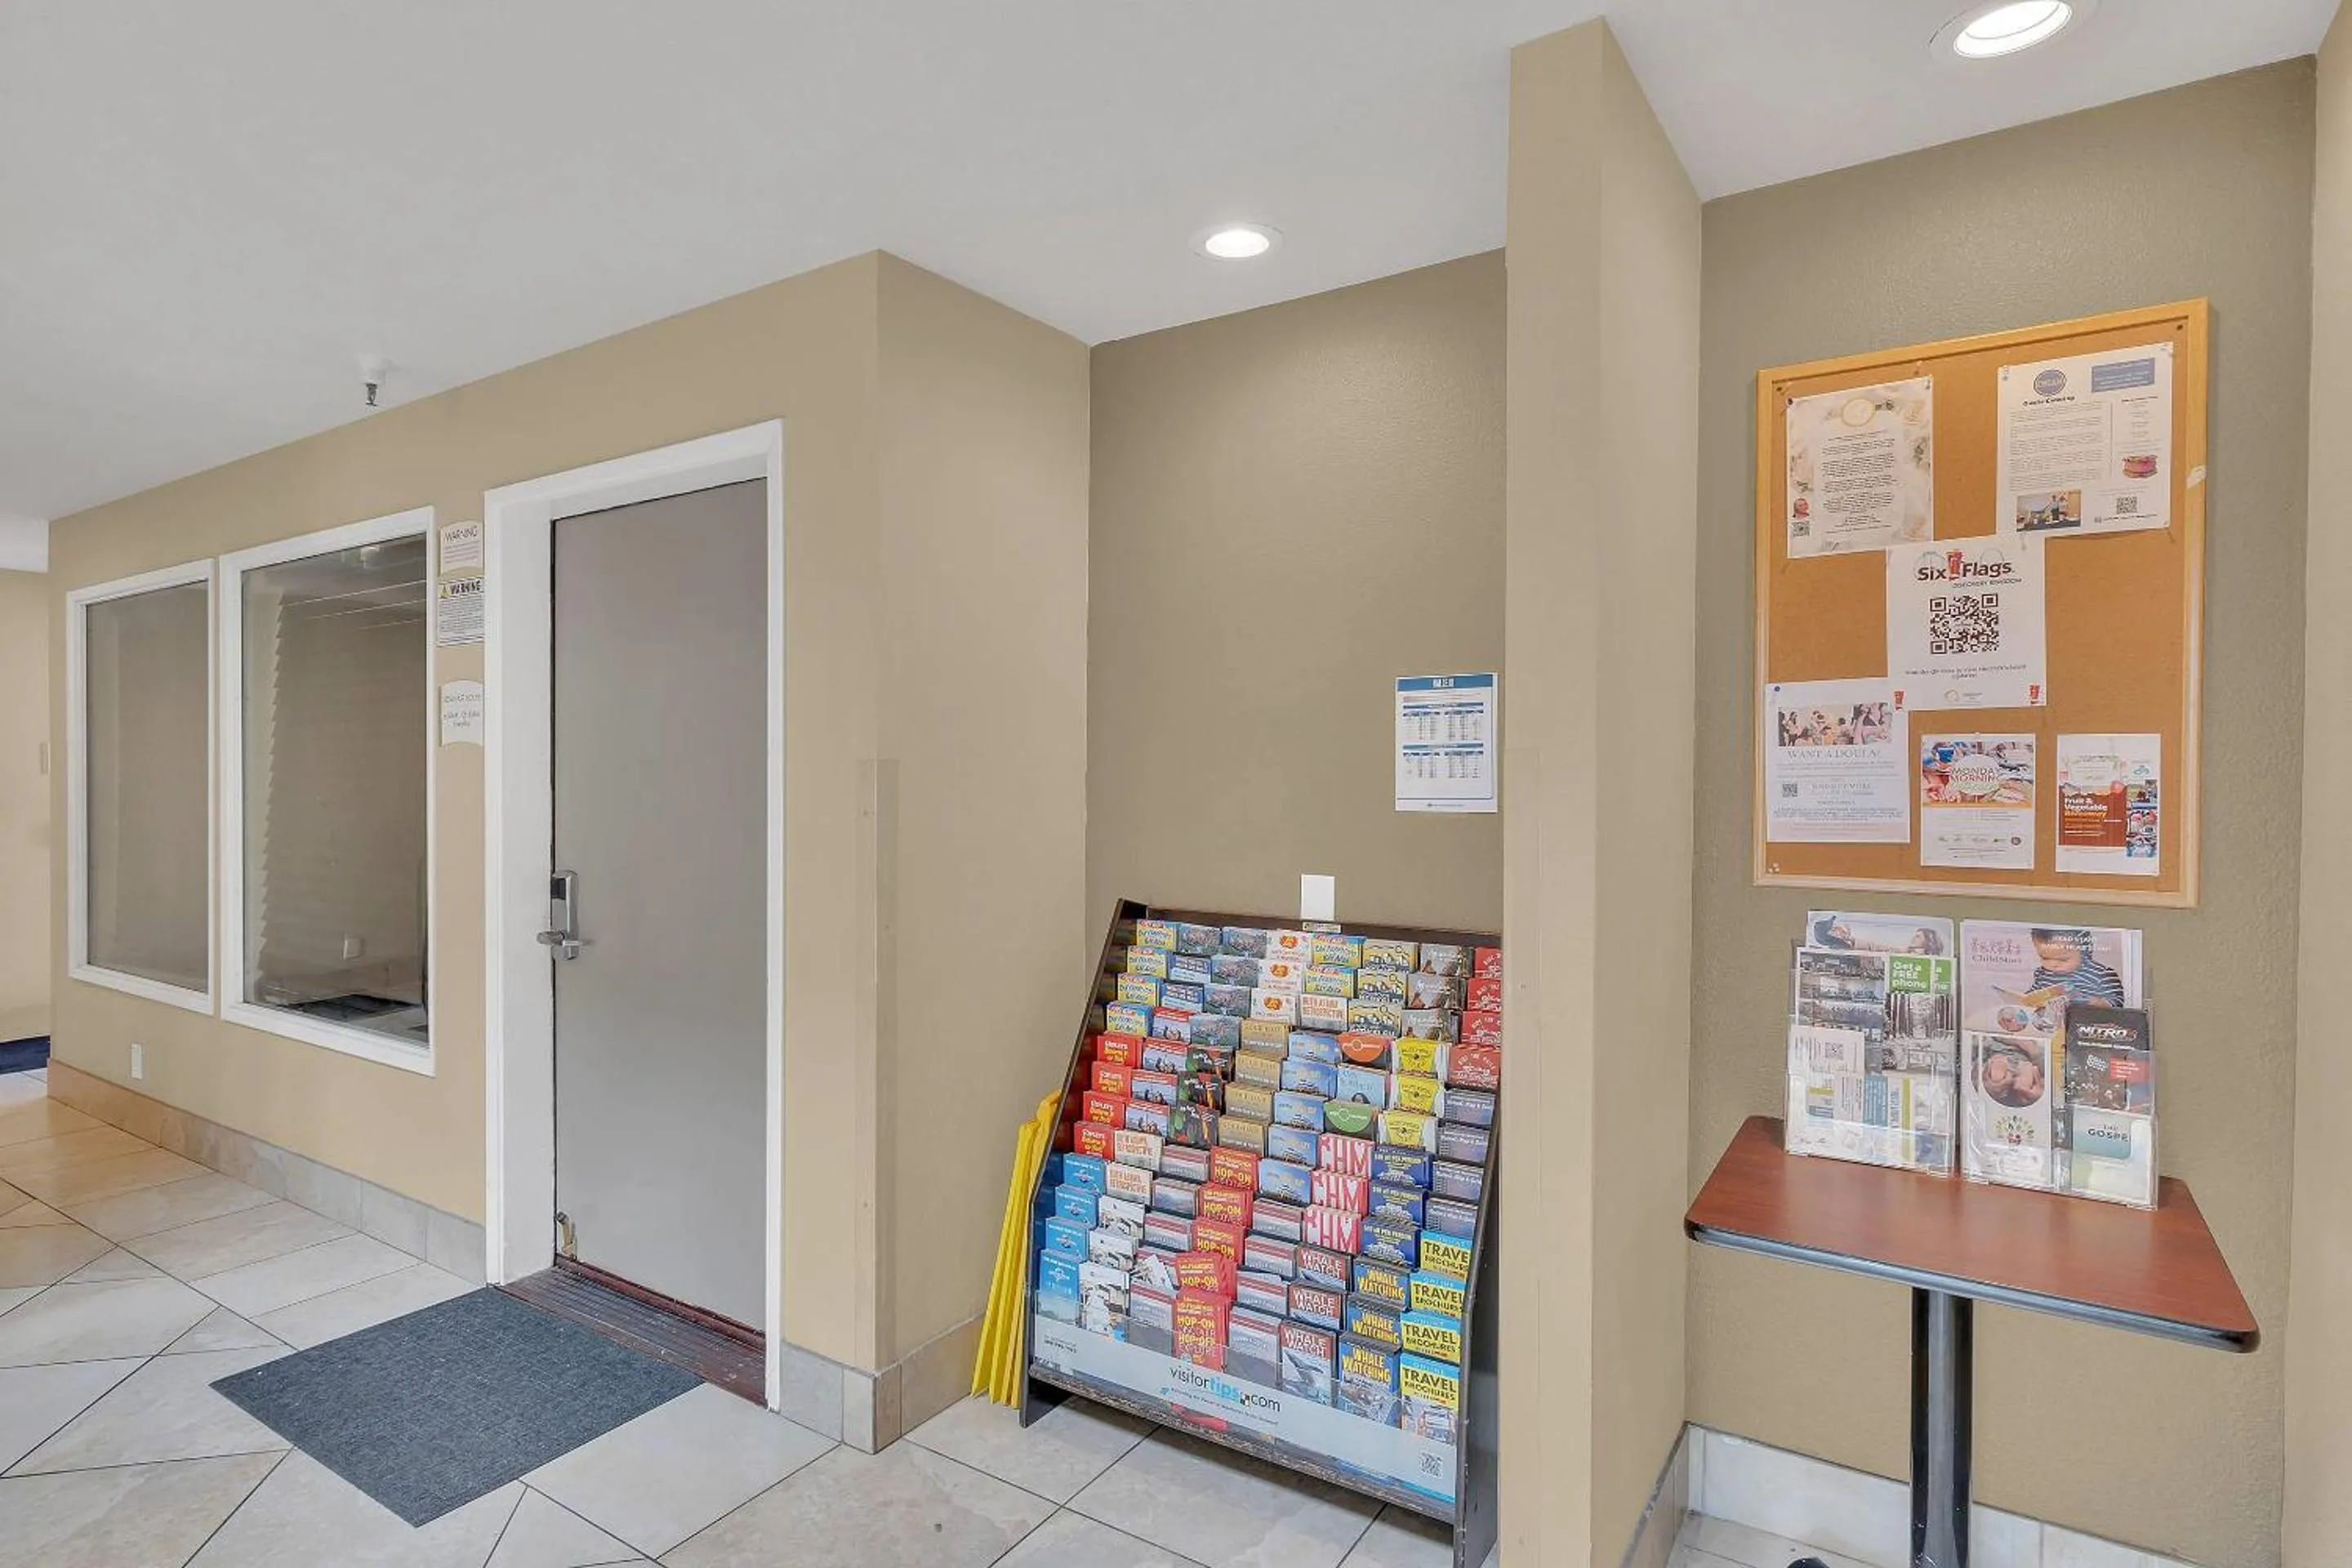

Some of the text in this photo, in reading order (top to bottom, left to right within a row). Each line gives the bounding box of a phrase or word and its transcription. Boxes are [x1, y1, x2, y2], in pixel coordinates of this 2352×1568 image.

[1918, 562, 2012, 581] Six Flags
[1788, 750, 1822, 760] WANT
[1950, 767, 2000, 775] MONDAY
[1893, 969, 1919, 979] FREE
[1894, 961, 1913, 971] Get
[1892, 978, 1927, 989] phone
[1214, 1166, 1252, 1183] HOP-ON
[1204, 1201, 1241, 1216] HOP-ON
[1197, 1238, 1235, 1256] HOP-ON
[1424, 1241, 1468, 1263] TRAVE
[1301, 1250, 1342, 1269] WHALE
[1305, 1261, 1342, 1281] WATCH
[1181, 1276, 1218, 1288] HOP-ON
[1358, 1276, 1404, 1299] WATCHING
[1294, 1290, 1335, 1307] WHALE
[1297, 1301, 1334, 1317] WATCH
[1177, 1315, 1215, 1329] HOP-ON
[1361, 1312, 1394, 1331] WHALE
[1284, 1329, 1327, 1348] WHALE
[1352, 1320, 1400, 1344] WATCHING
[1404, 1324, 1457, 1345] TRAVEL
[1287, 1341, 1325, 1359] WATCH
[1352, 1347, 1385, 1368] WHALE
[1342, 1355, 1392, 1383] WATCHING
[1404, 1368, 1457, 1393] TRAVEL
